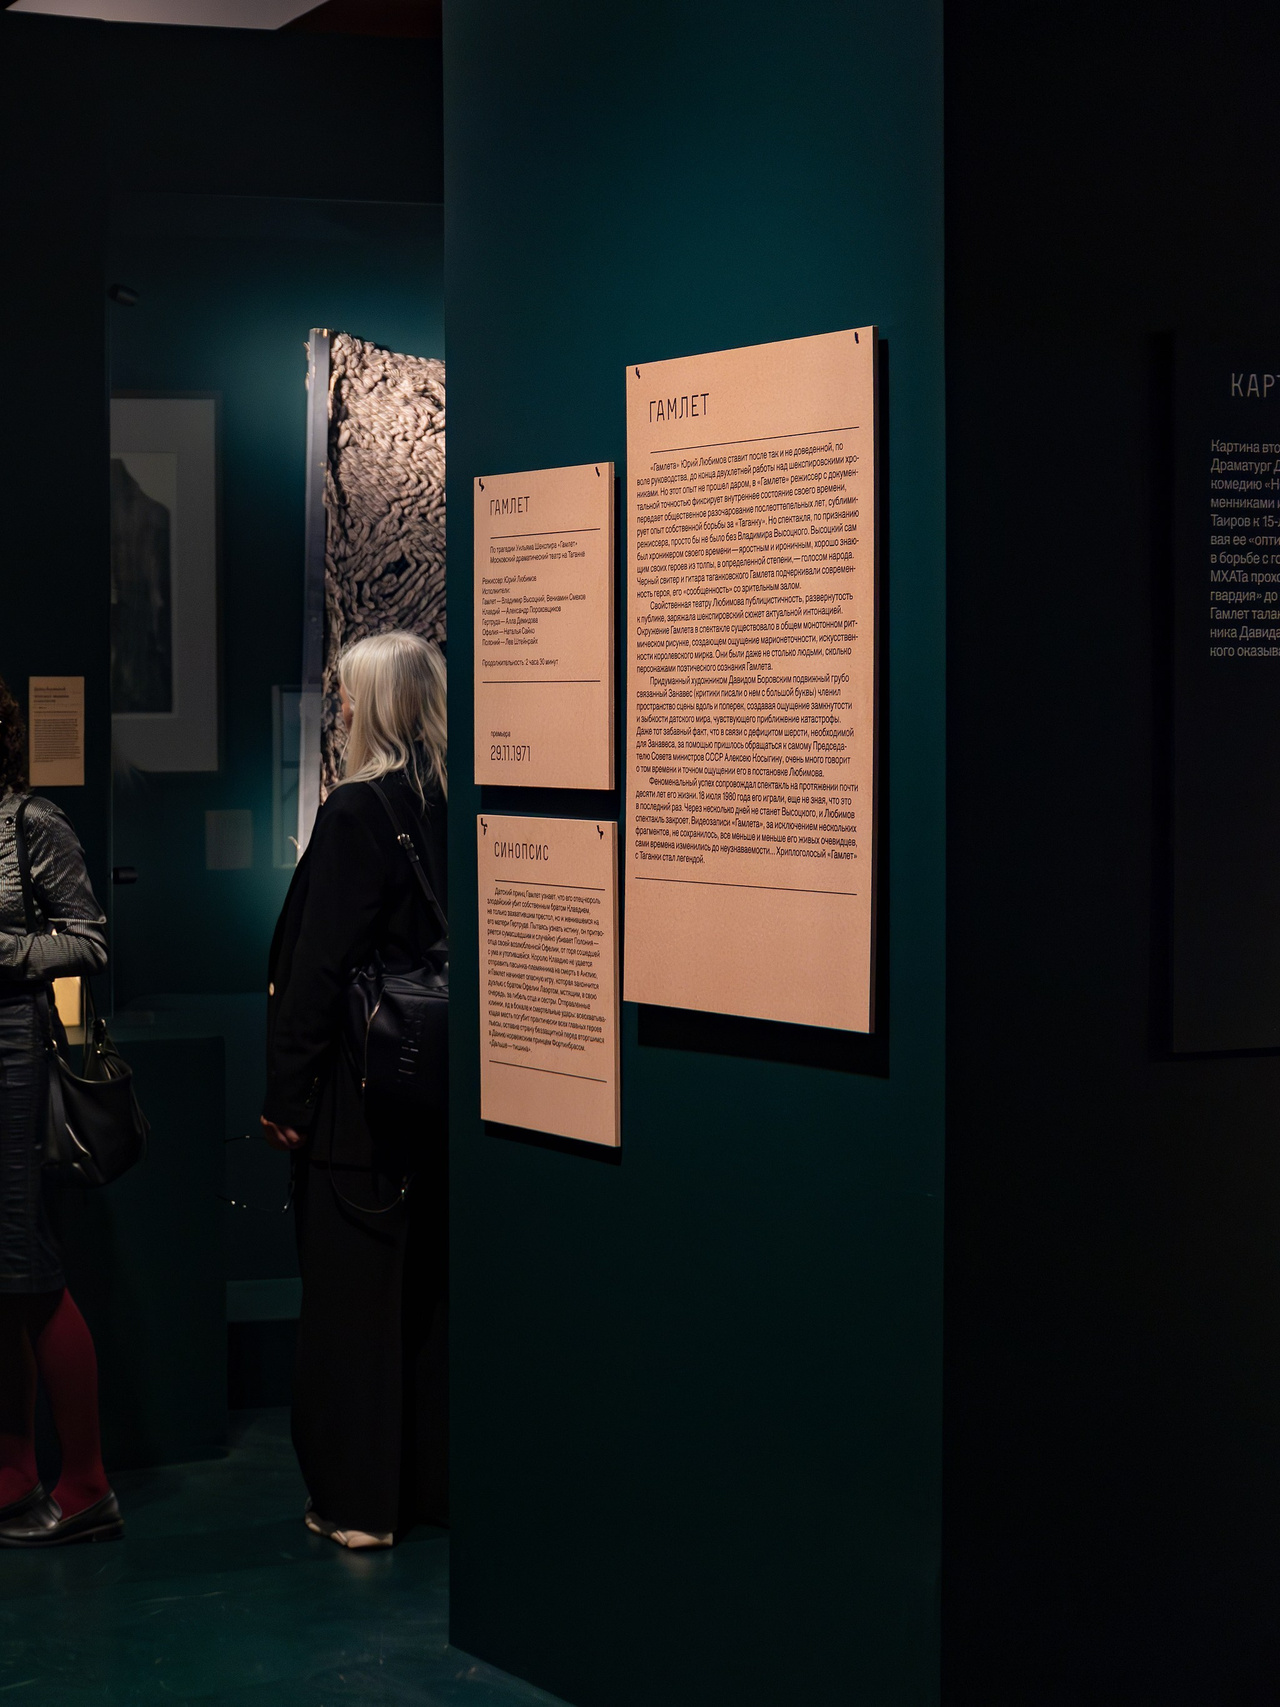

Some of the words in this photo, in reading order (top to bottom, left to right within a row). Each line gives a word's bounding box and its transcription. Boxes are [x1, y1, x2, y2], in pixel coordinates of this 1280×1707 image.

[649, 392, 710, 423] ГАМЛЕТ
[1211, 439, 1260, 455] Картина
[1210, 458, 1272, 475] Драматург
[1210, 480, 1263, 492] комедию
[637, 500, 660, 510] тальной
[660, 499, 691, 508] точностью
[692, 494, 723, 507] фиксирует
[724, 492, 760, 504] внутреннее
[760, 489, 793, 499] состояние
[794, 487, 815, 496] своего
[816, 484, 846, 495] времени,
[1210, 498, 1275, 509] менниками
[490, 496, 531, 516] ГАМЛЕТ
[1210, 514, 1251, 530] Таиров
[1253, 517, 1260, 527] к
[636, 539, 670, 549] режиссера,
[670, 537, 691, 547] просто
[692, 534, 700, 544] бы
[709, 532, 725, 542] было
[725, 531, 736, 541] без
[737, 528, 772, 542] Владимира
[773, 526, 809, 539] Высоцкого.
[810, 523, 843, 536] Высоцкий
[844, 524, 857, 532] сам
[1210, 536, 1231, 545] вая
[1233, 536, 1247, 546] ее
[1210, 554, 1218, 564] в
[1220, 552, 1261, 567] борьбе
[1262, 554, 1269, 564] с
[1210, 570, 1249, 583] МХАТа
[650, 599, 691, 609] Свойственная
[692, 600, 711, 609] театру
[712, 596, 744, 606] Любимова
[745, 593, 804, 606] публицистичность,
[805, 593, 853, 604] развернутость
[1210, 591, 1262, 604] гвардия»
[1264, 592, 1279, 604] до
[1210, 606, 1251, 620] Гамлет
[1210, 628, 1238, 639] ника
[1210, 647, 1235, 657] кого
[1237, 646, 1280, 657] оказыв
[649, 675, 690, 686] Придуманный
[691, 677, 727, 686] художником
[728, 674, 756, 685] Давидом
[756, 674, 792, 685] Боровским
[792, 673, 830, 684] подвижный
[831, 673, 849, 684] грубо
[636, 703, 676, 711] пространство
[676, 703, 695, 711] сцены
[695, 703, 713, 711] вдоль
[718, 703, 745, 711] поперек,
[746, 703, 775, 711] создавая
[776, 702, 810, 711] ощущение
[810, 702, 852, 711] замкнутости
[490, 745, 531, 762] 29.11.1971
[650, 751, 672, 760] Совета
[672, 754, 704, 762] министров
[705, 752, 723, 761] СССР
[724, 753, 751, 762] Алексею
[752, 753, 784, 764] Косыгину,
[824, 756, 850, 766] говорит
[635, 815, 664, 823] спектакль
[665, 817, 690, 826] закроет.
[690, 816, 730, 828] Видеозаписи
[731, 818, 765, 830] «Гамлета»,
[774, 822, 818, 830] исключением
[818, 824, 856, 832] нескольких
[494, 841, 550, 861] СИНОПСИС
[640, 851, 661, 860] Таганки
[676, 853, 704, 865] легендой.
